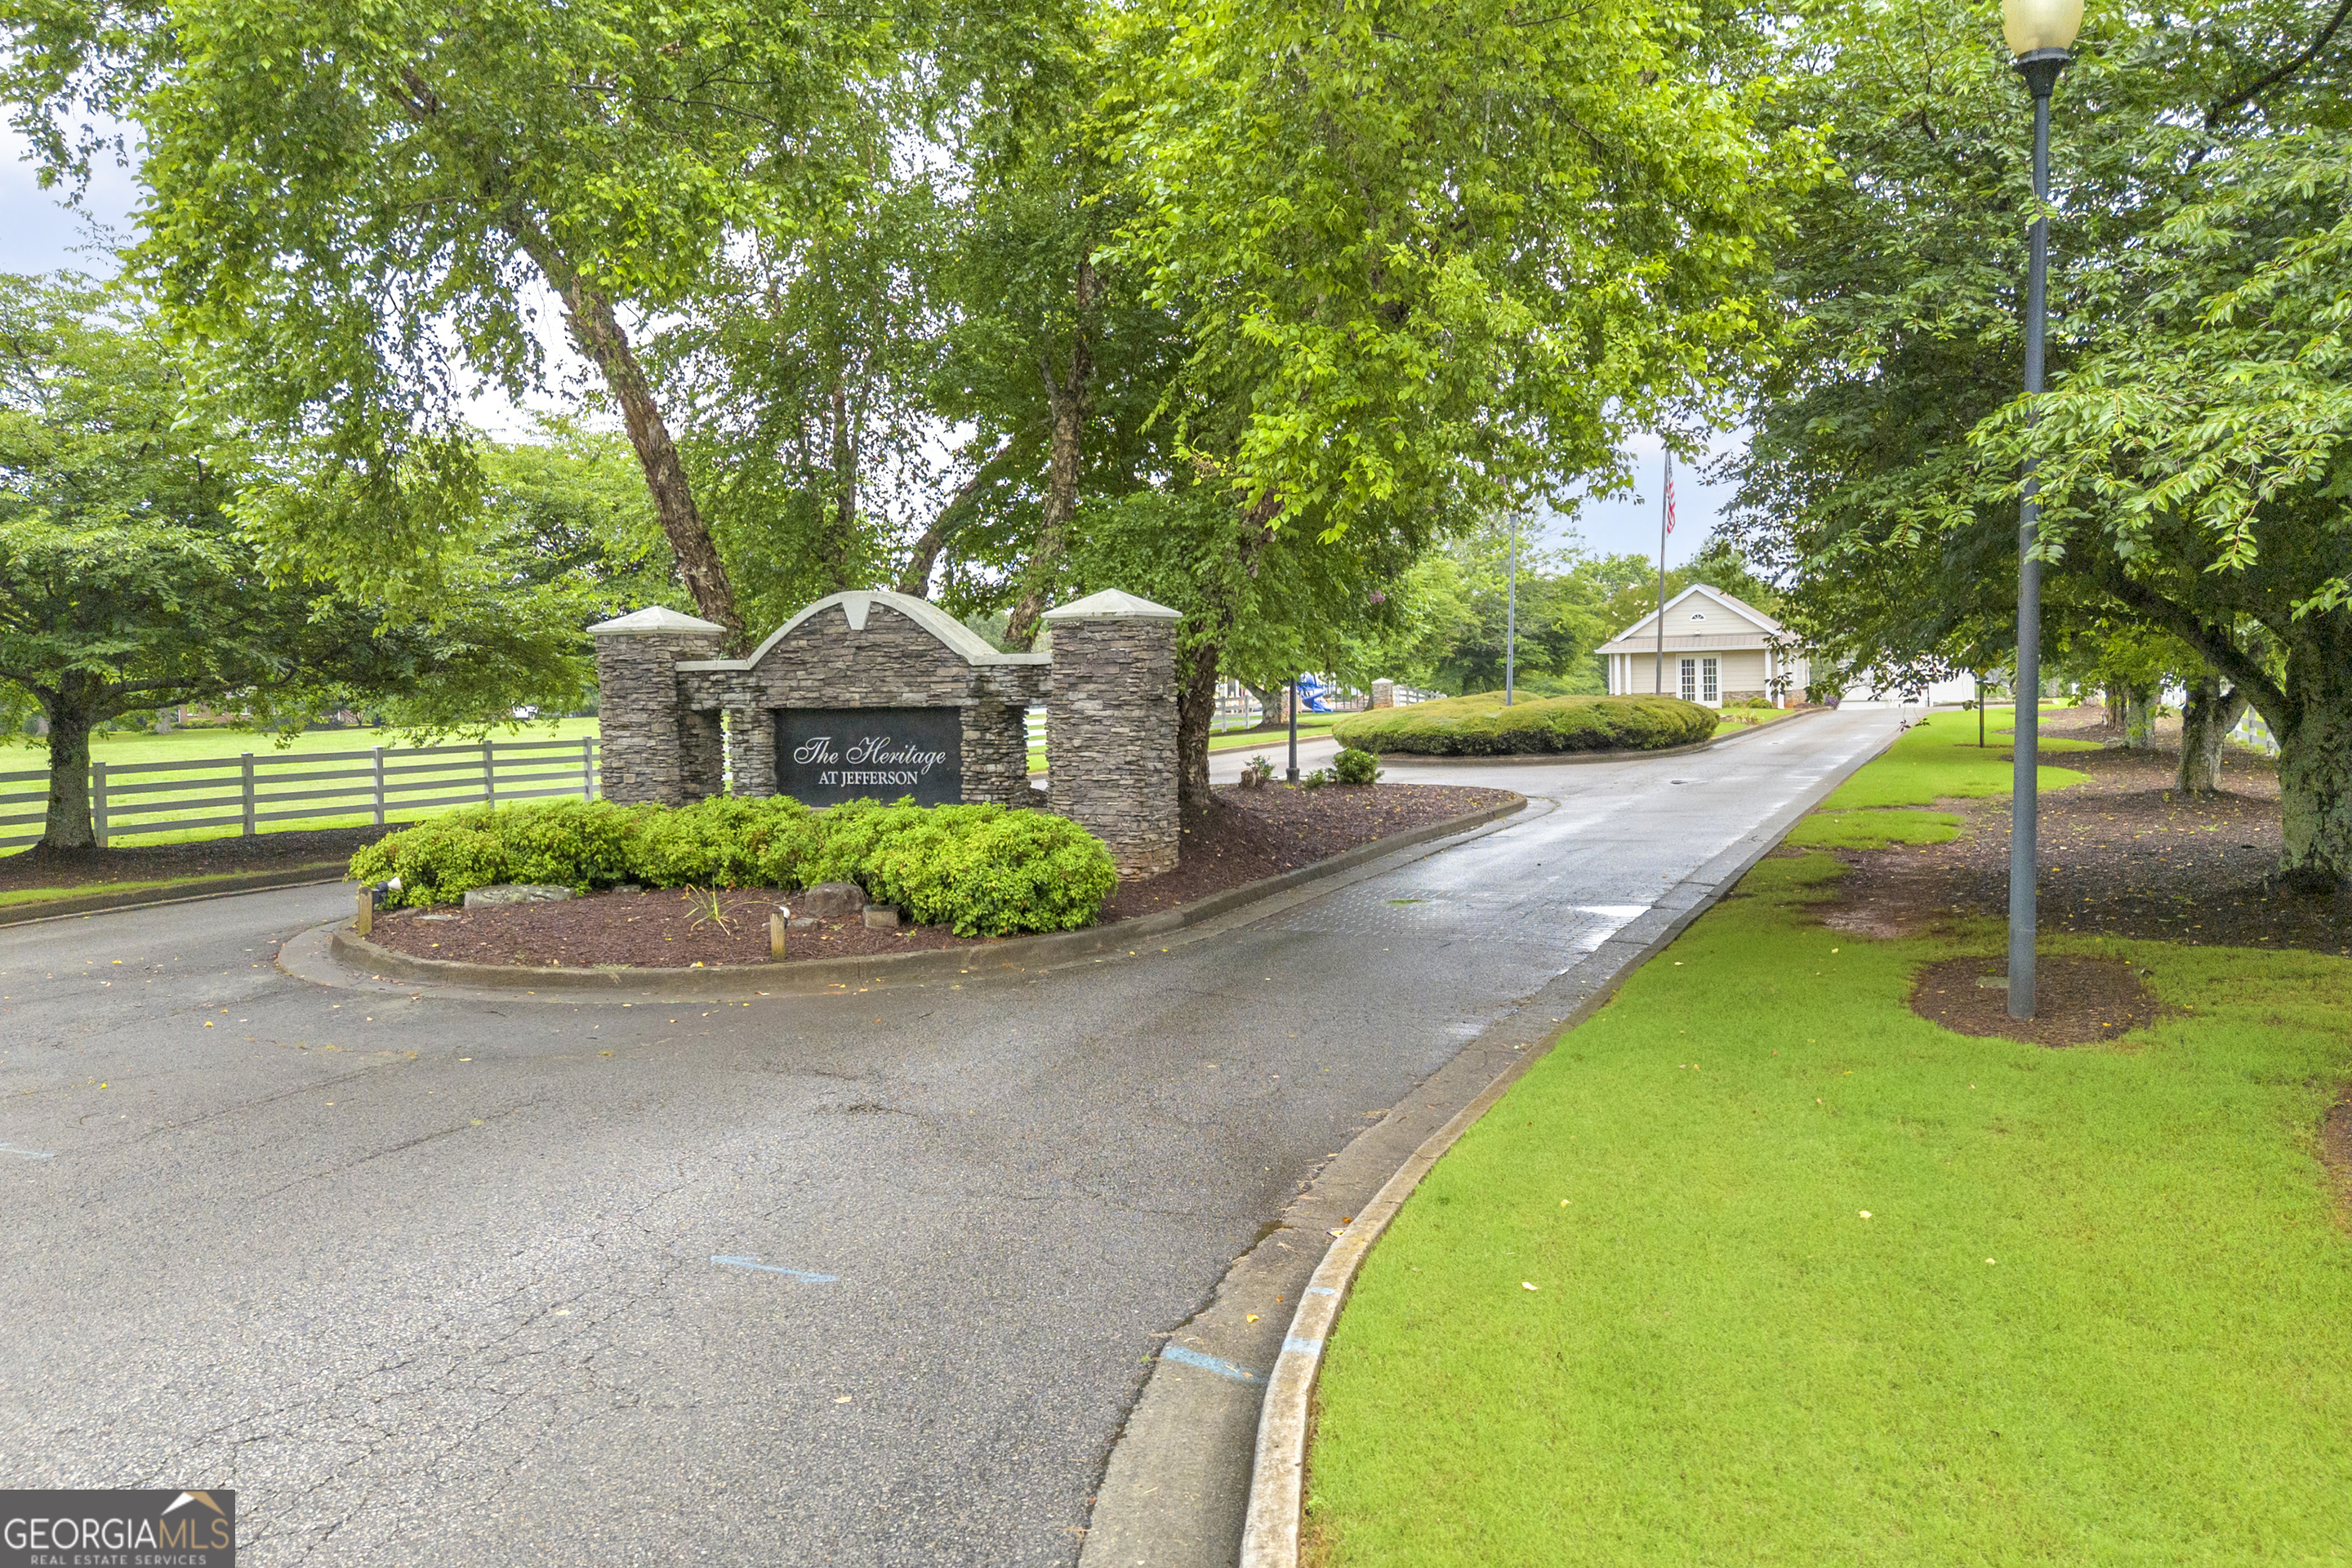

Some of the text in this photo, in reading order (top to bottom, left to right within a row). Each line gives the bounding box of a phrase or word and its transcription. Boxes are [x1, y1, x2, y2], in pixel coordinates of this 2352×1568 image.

[794, 737, 947, 775] The Heritage
[818, 771, 918, 787] AT JEFFERSON
